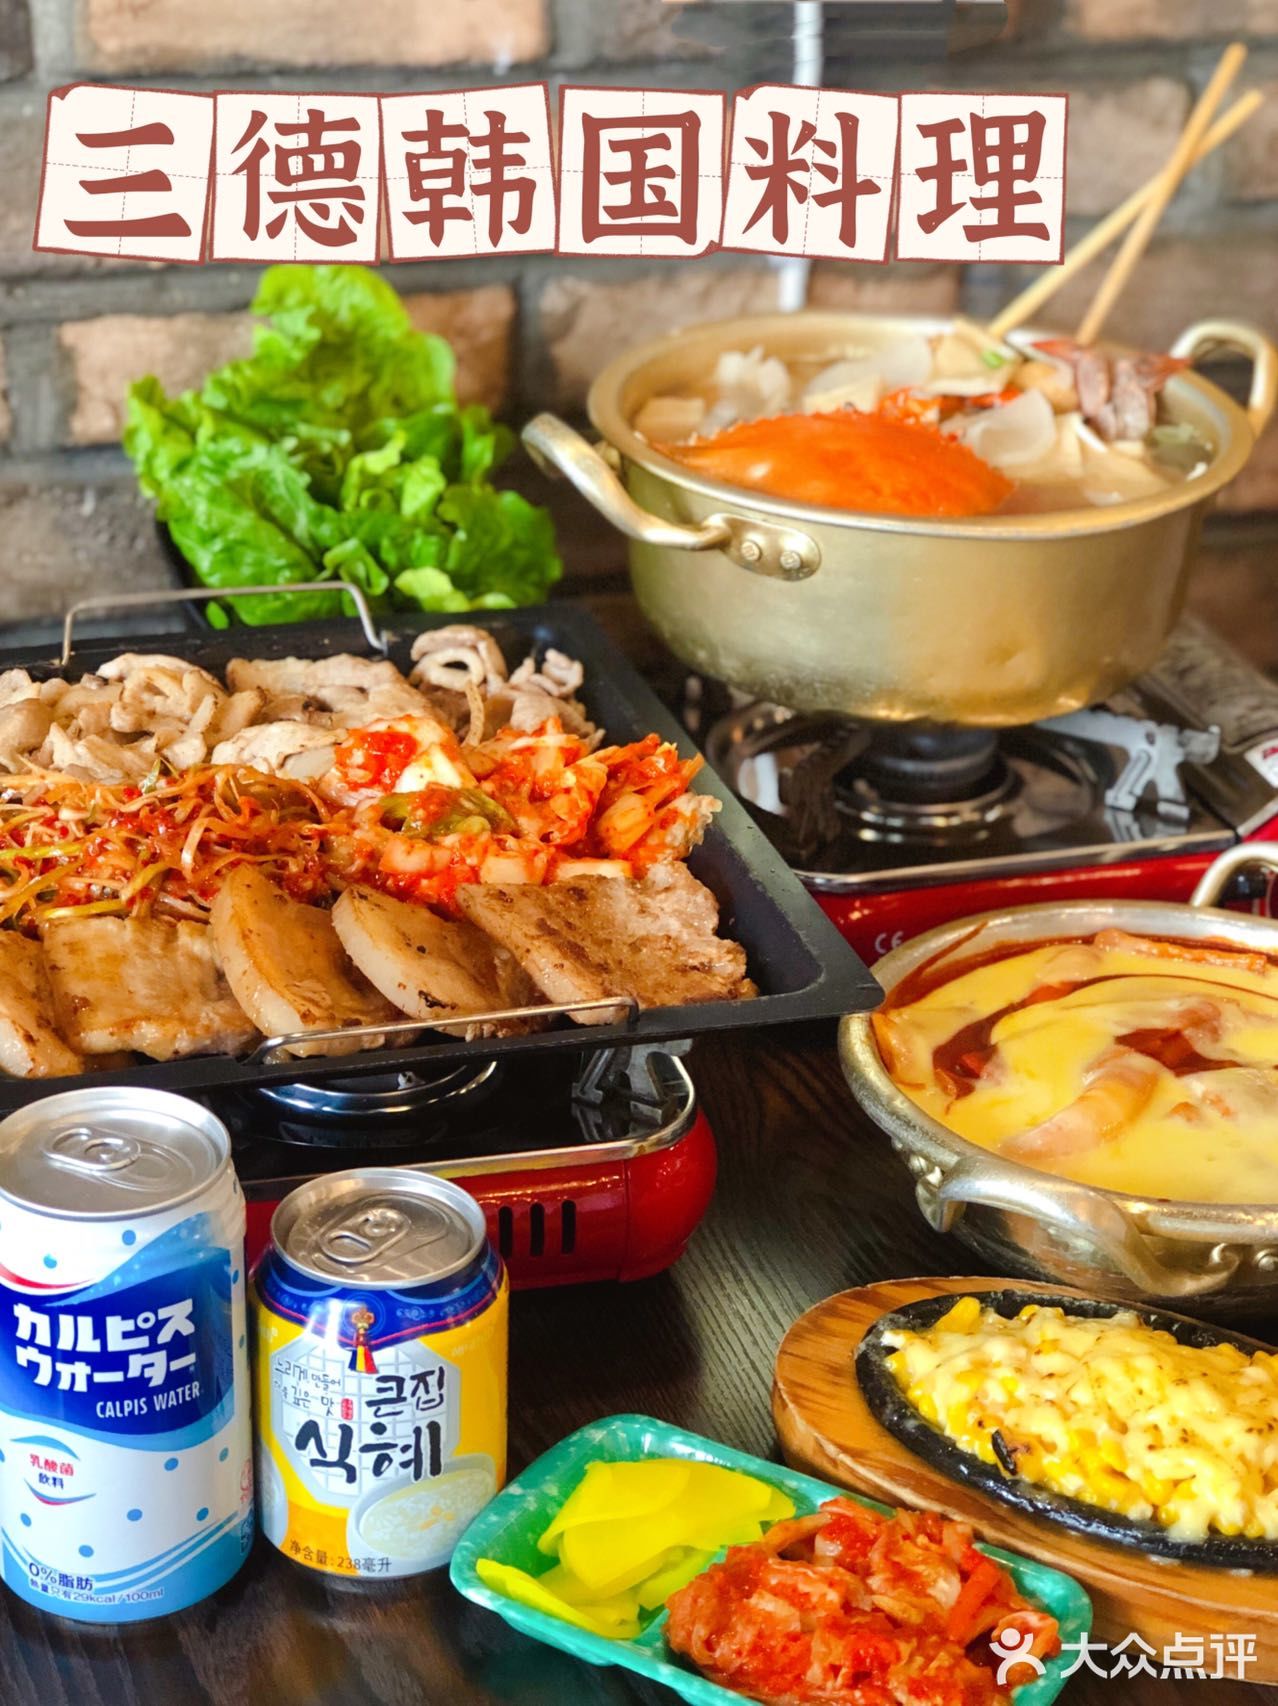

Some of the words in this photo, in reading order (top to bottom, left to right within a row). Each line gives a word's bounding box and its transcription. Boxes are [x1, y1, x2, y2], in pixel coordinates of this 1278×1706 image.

[13, 1298, 195, 1352] カルピス
[15, 1350, 196, 1392] ウォーター
[275, 1359, 308, 1381] 느리게
[311, 1373, 341, 1391] 만들어
[96, 1397, 148, 1418] CALPIS
[153, 1381, 200, 1411] WATER
[321, 1396, 334, 1416] 맛
[365, 1366, 446, 1417] 큰집
[30, 1453, 74, 1477] 乳酸菌
[295, 1420, 442, 1484] 식혜
[38, 1472, 64, 1489] 飲料
[29, 1562, 93, 1592] 0%脂肪
